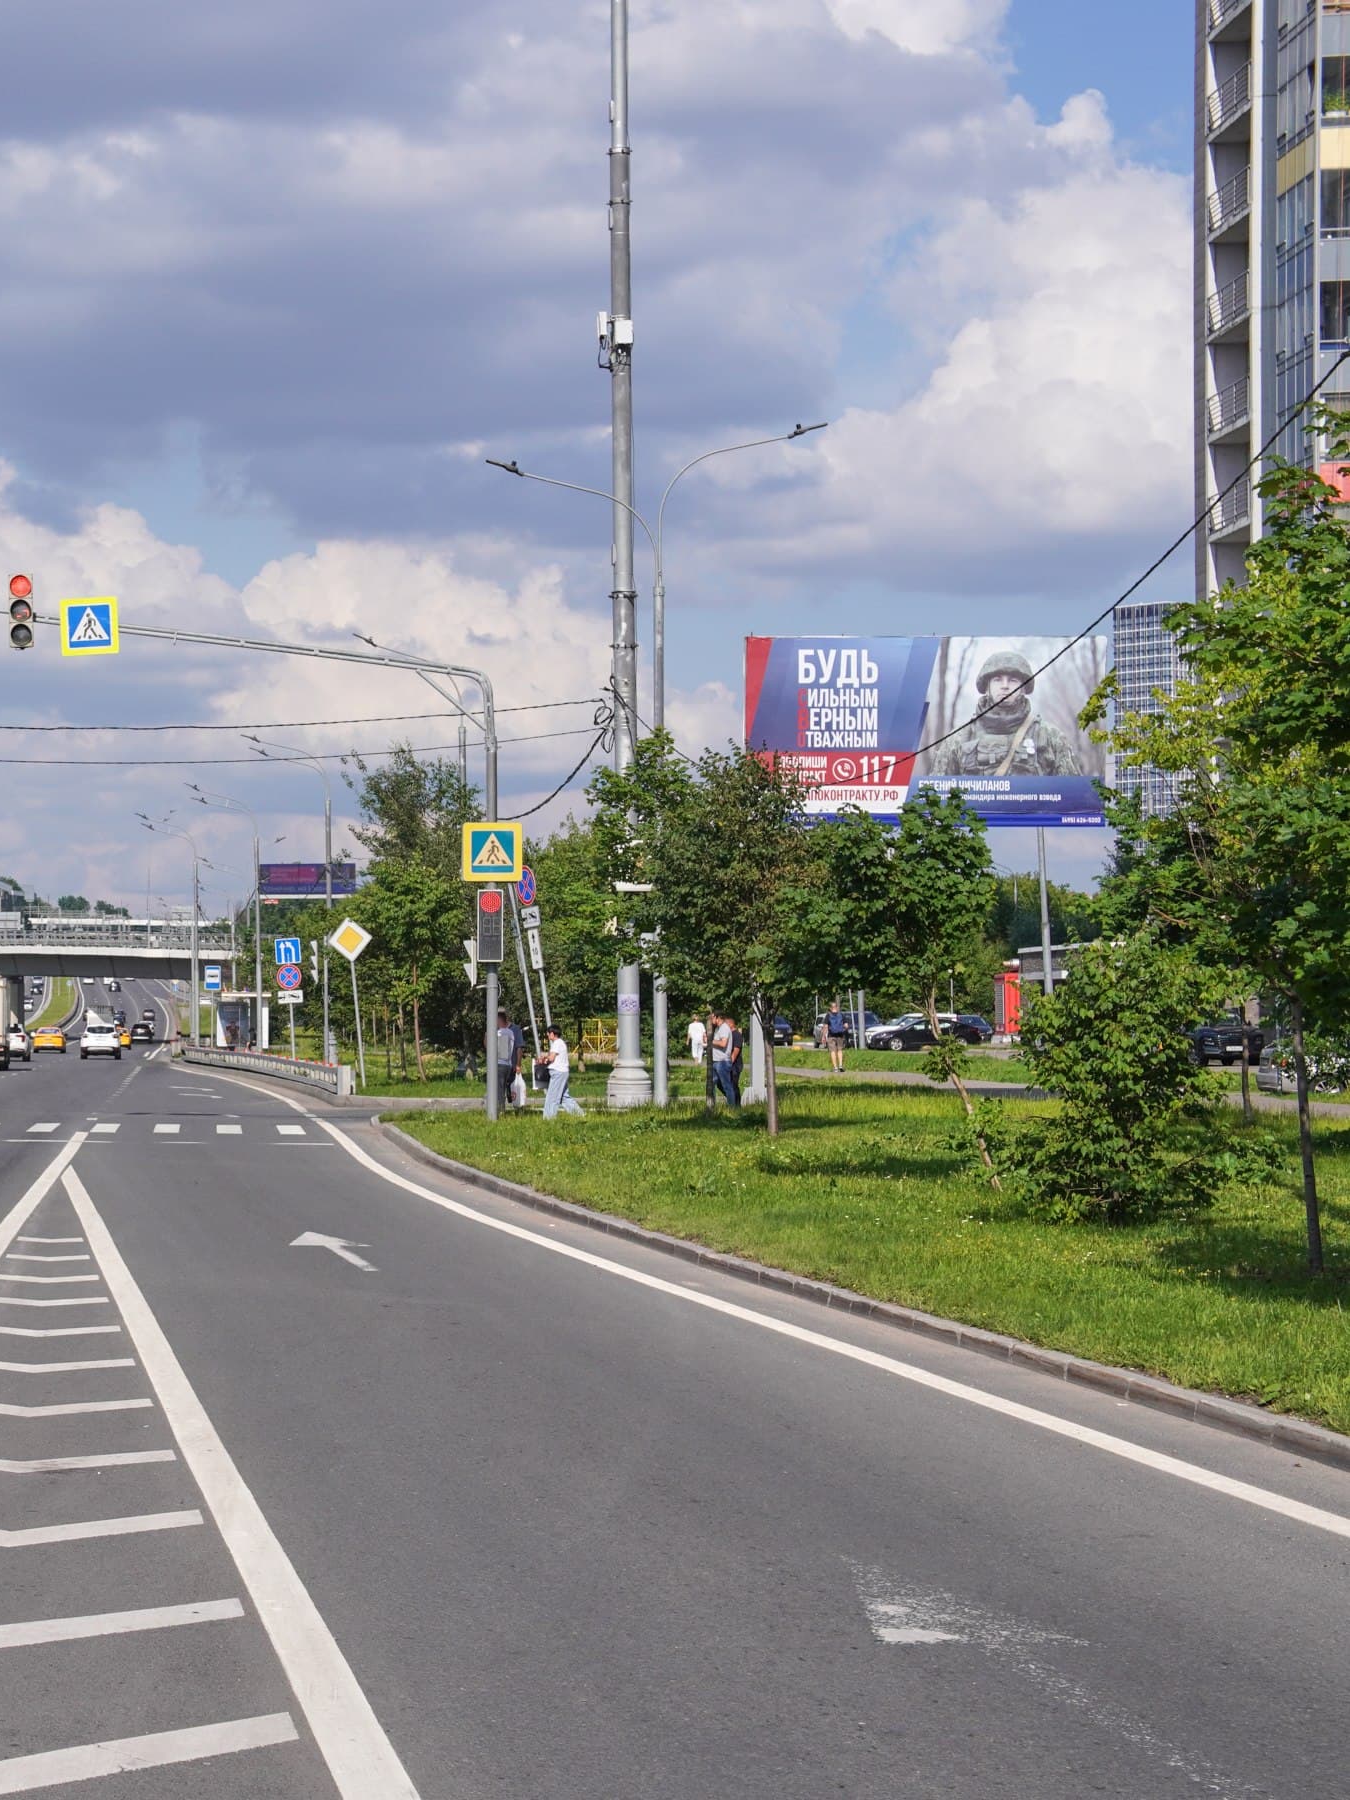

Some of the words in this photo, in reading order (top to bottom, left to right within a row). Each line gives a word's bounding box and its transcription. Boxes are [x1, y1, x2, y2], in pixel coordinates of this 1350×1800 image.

[798, 649, 879, 688] БУДЬ
[797, 688, 878, 707] СИЛЬНЫМ
[797, 707, 878, 730] ВЕРНЫМ
[797, 731, 878, 748] ОТВАЖНЫМ
[859, 755, 896, 783] 117
